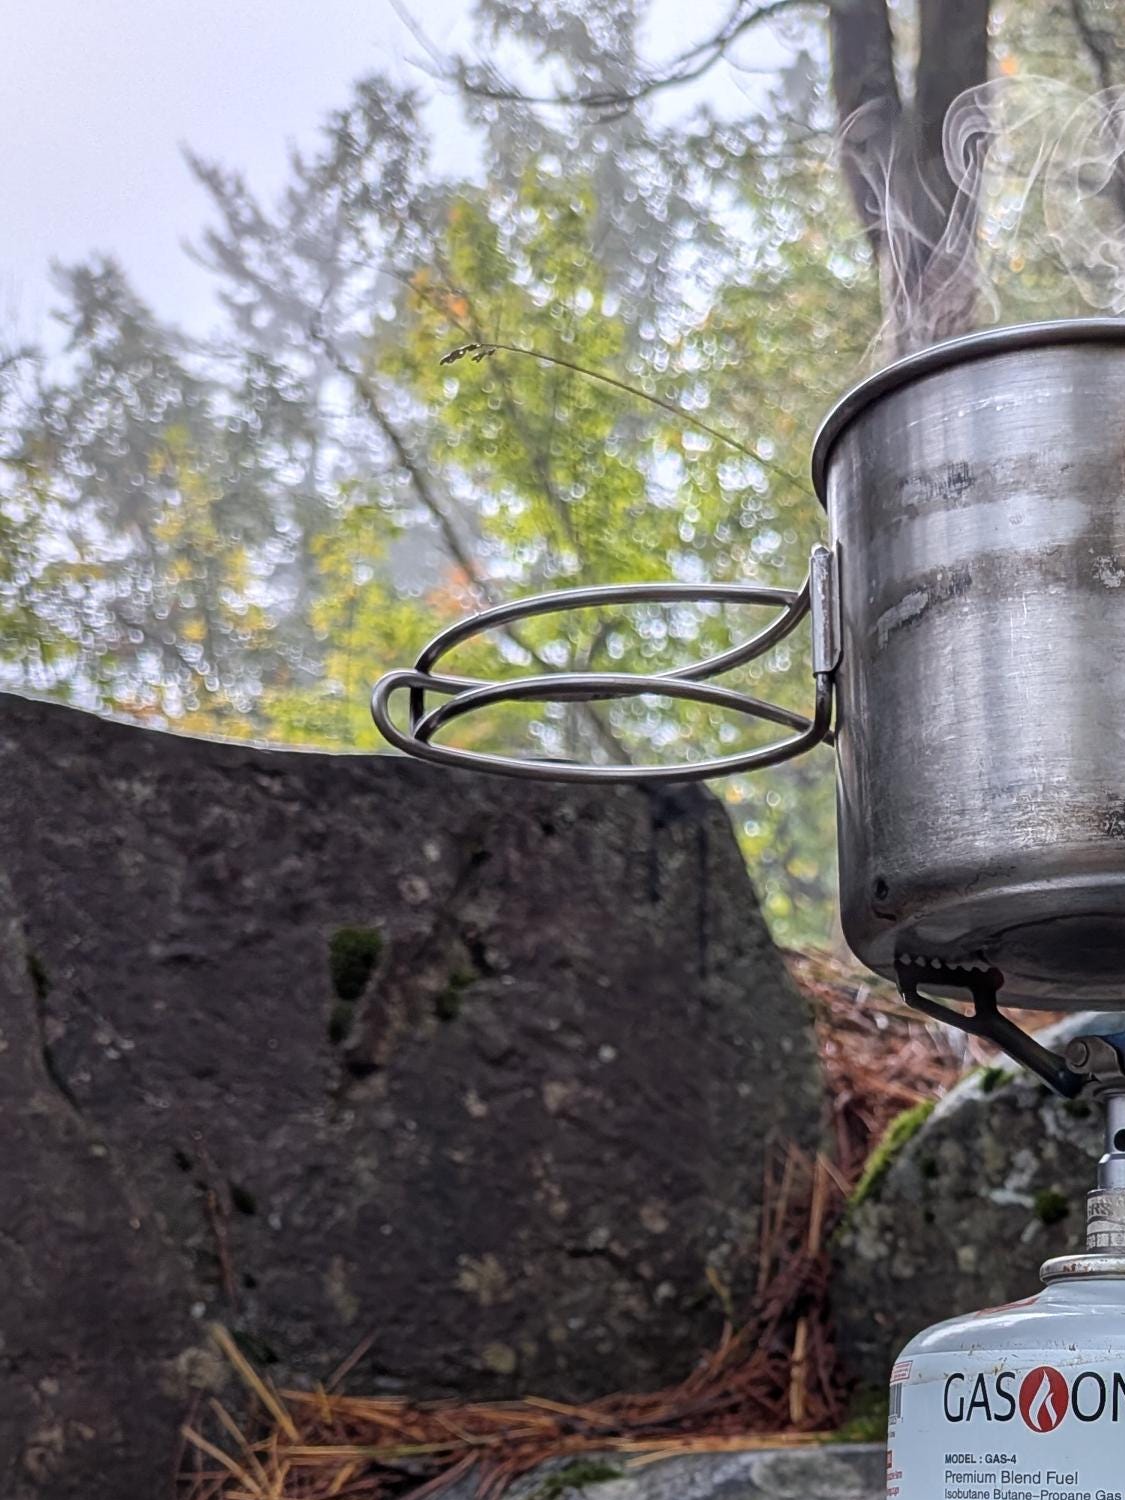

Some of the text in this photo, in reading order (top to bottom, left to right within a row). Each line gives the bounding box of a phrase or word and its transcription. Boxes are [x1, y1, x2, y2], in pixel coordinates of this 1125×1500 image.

[944, 1372, 1016, 1422] GAS
[944, 1454, 976, 1464] MODEL
[985, 1454, 1017, 1464] GAS-4
[944, 1470, 1078, 1485] Premium Blend Fuel
[944, 1488, 990, 1500] Isobutane
